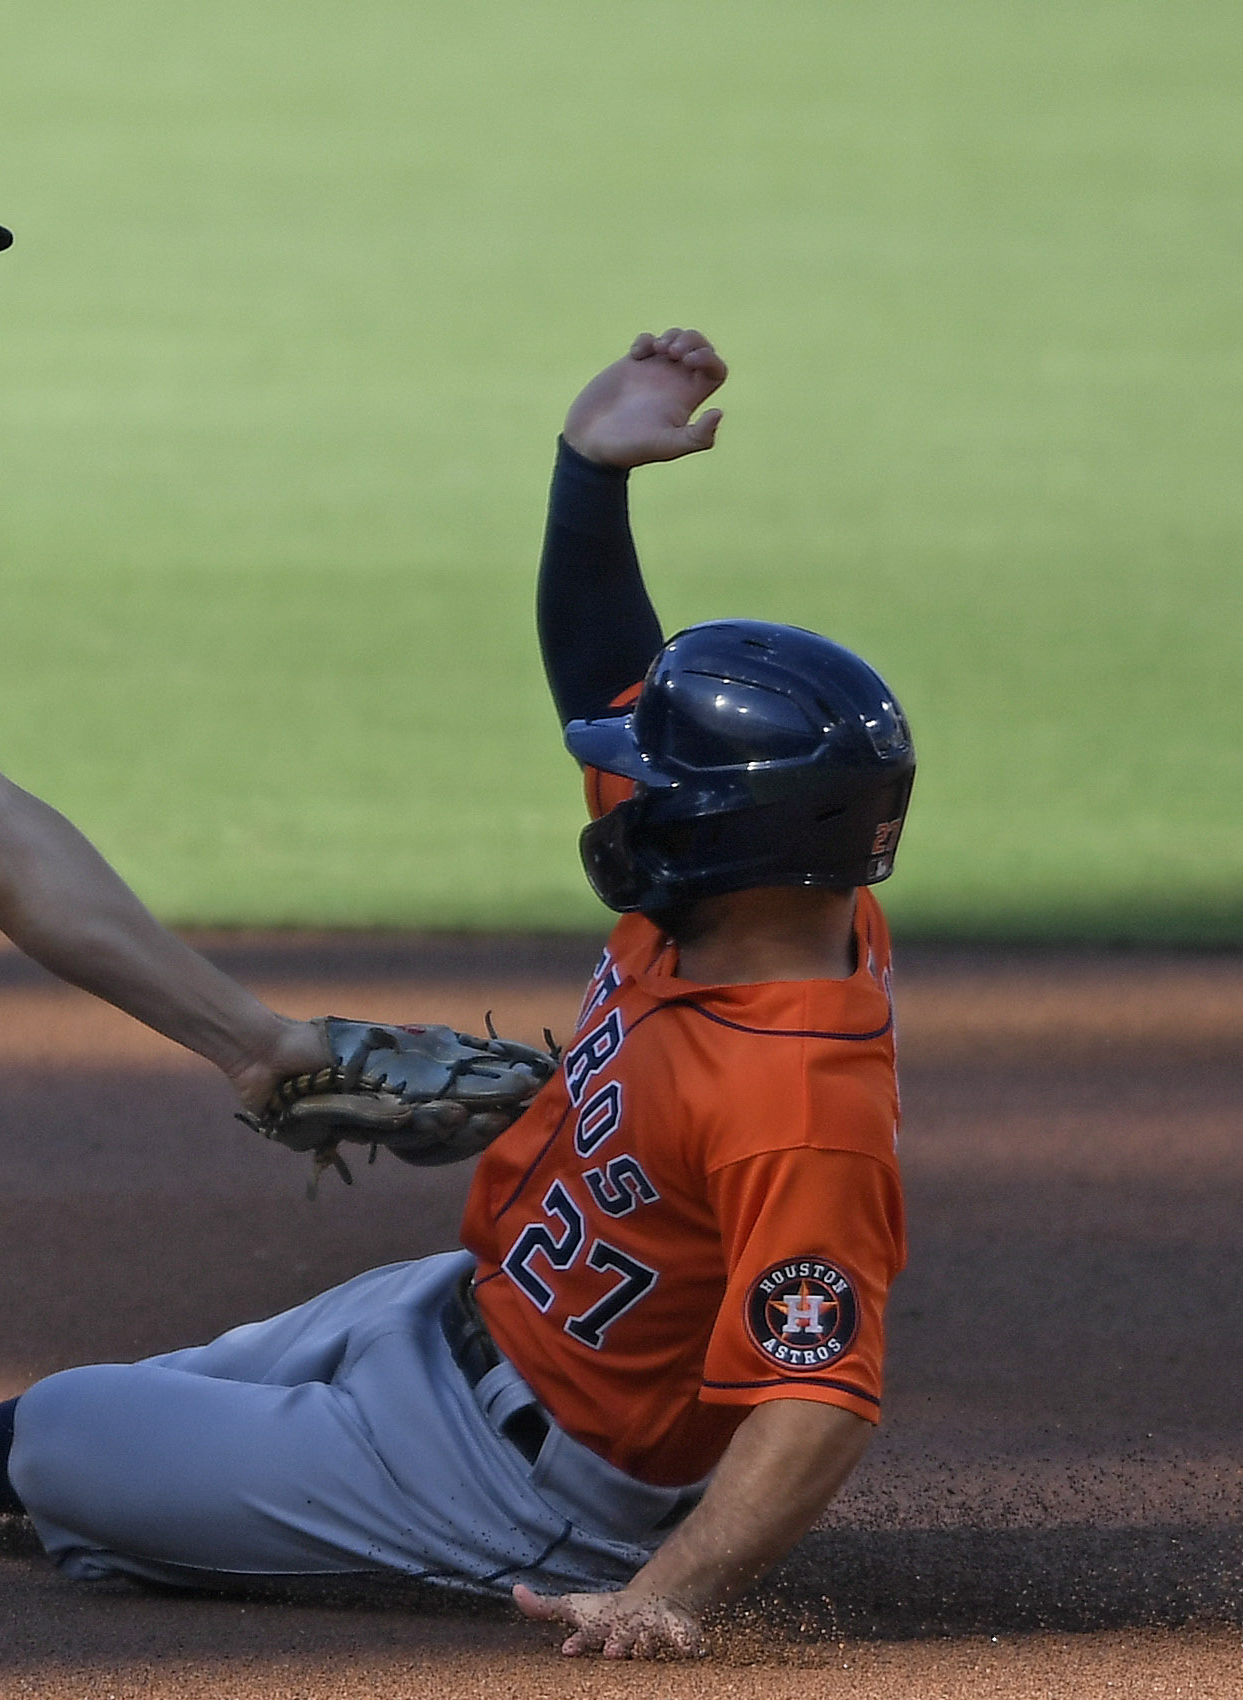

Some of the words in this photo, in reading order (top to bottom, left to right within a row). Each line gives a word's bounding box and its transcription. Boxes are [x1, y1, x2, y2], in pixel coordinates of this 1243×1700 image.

[563, 946, 661, 1219] TROS
[501, 1178, 659, 1350] 27
[759, 1263, 848, 1294] HOUSTON
[781, 1294, 825, 1333] H
[762, 1338, 842, 1364] ASTROS
